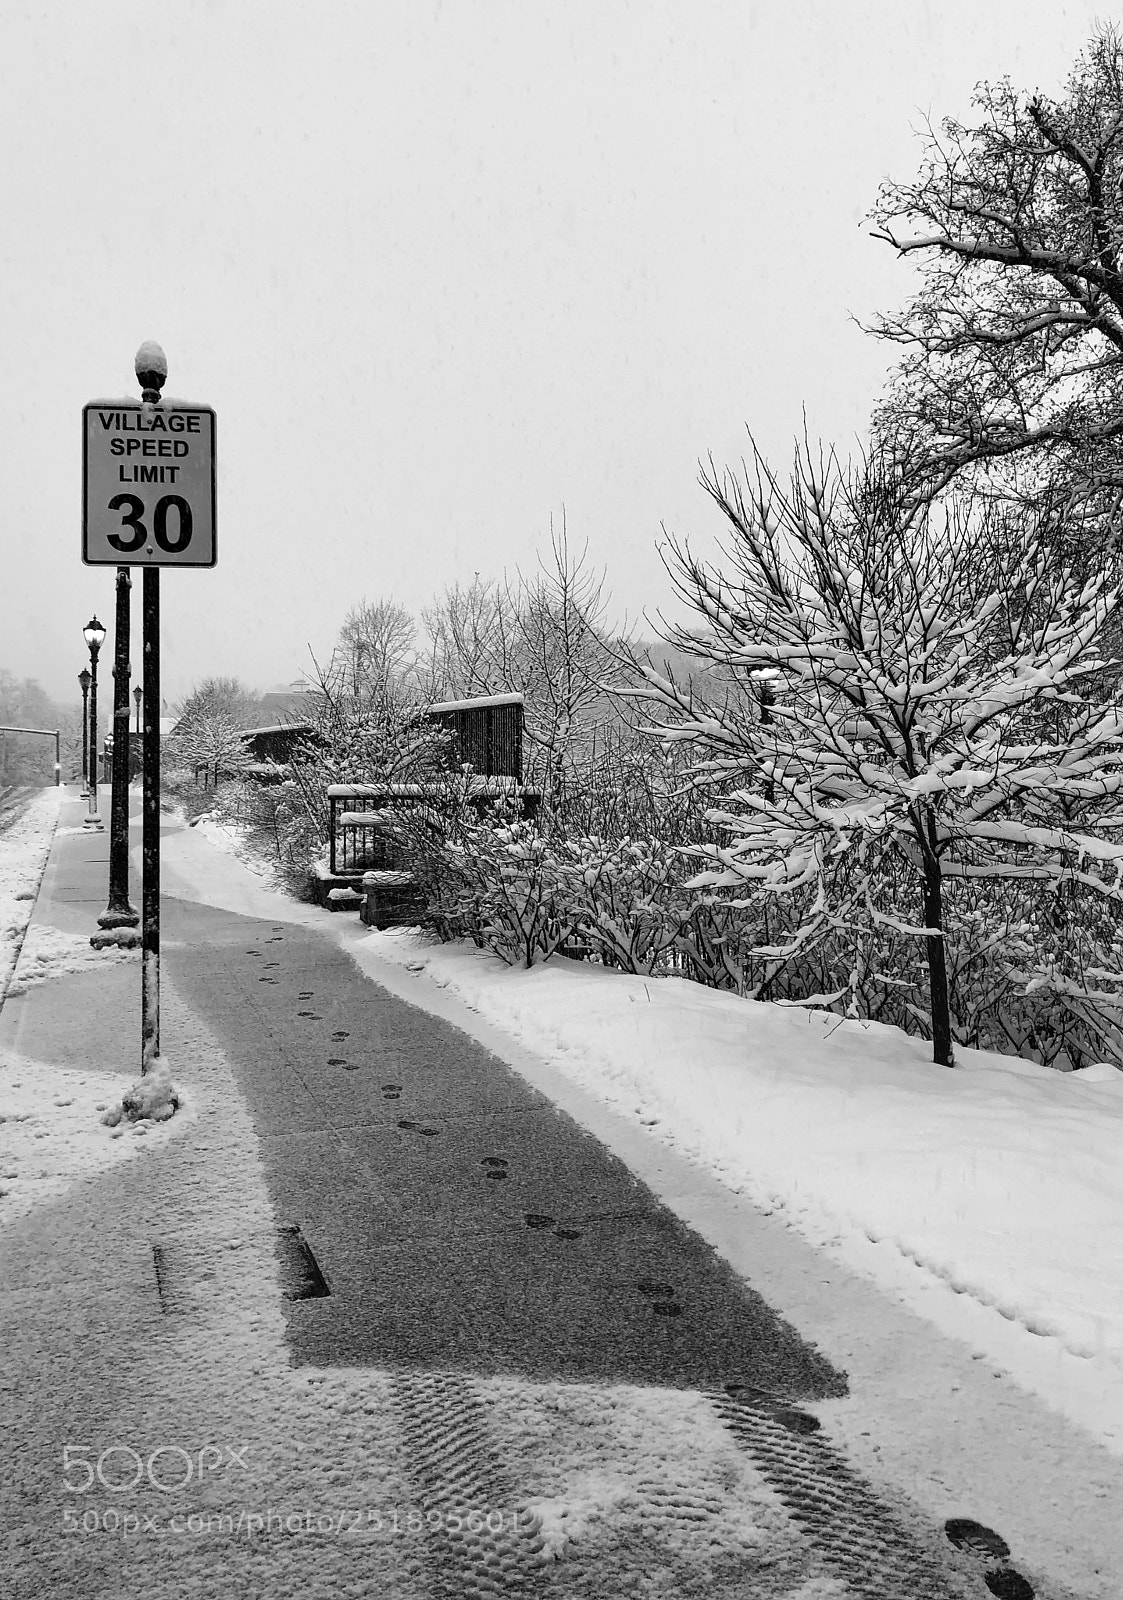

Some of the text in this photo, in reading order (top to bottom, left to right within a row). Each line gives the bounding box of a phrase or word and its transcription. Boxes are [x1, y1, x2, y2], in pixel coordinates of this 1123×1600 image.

[98, 412, 201, 433] VILLAGE
[109, 438, 190, 458] SPEED
[119, 464, 180, 484] LIMIT
[106, 493, 193, 553] 30
